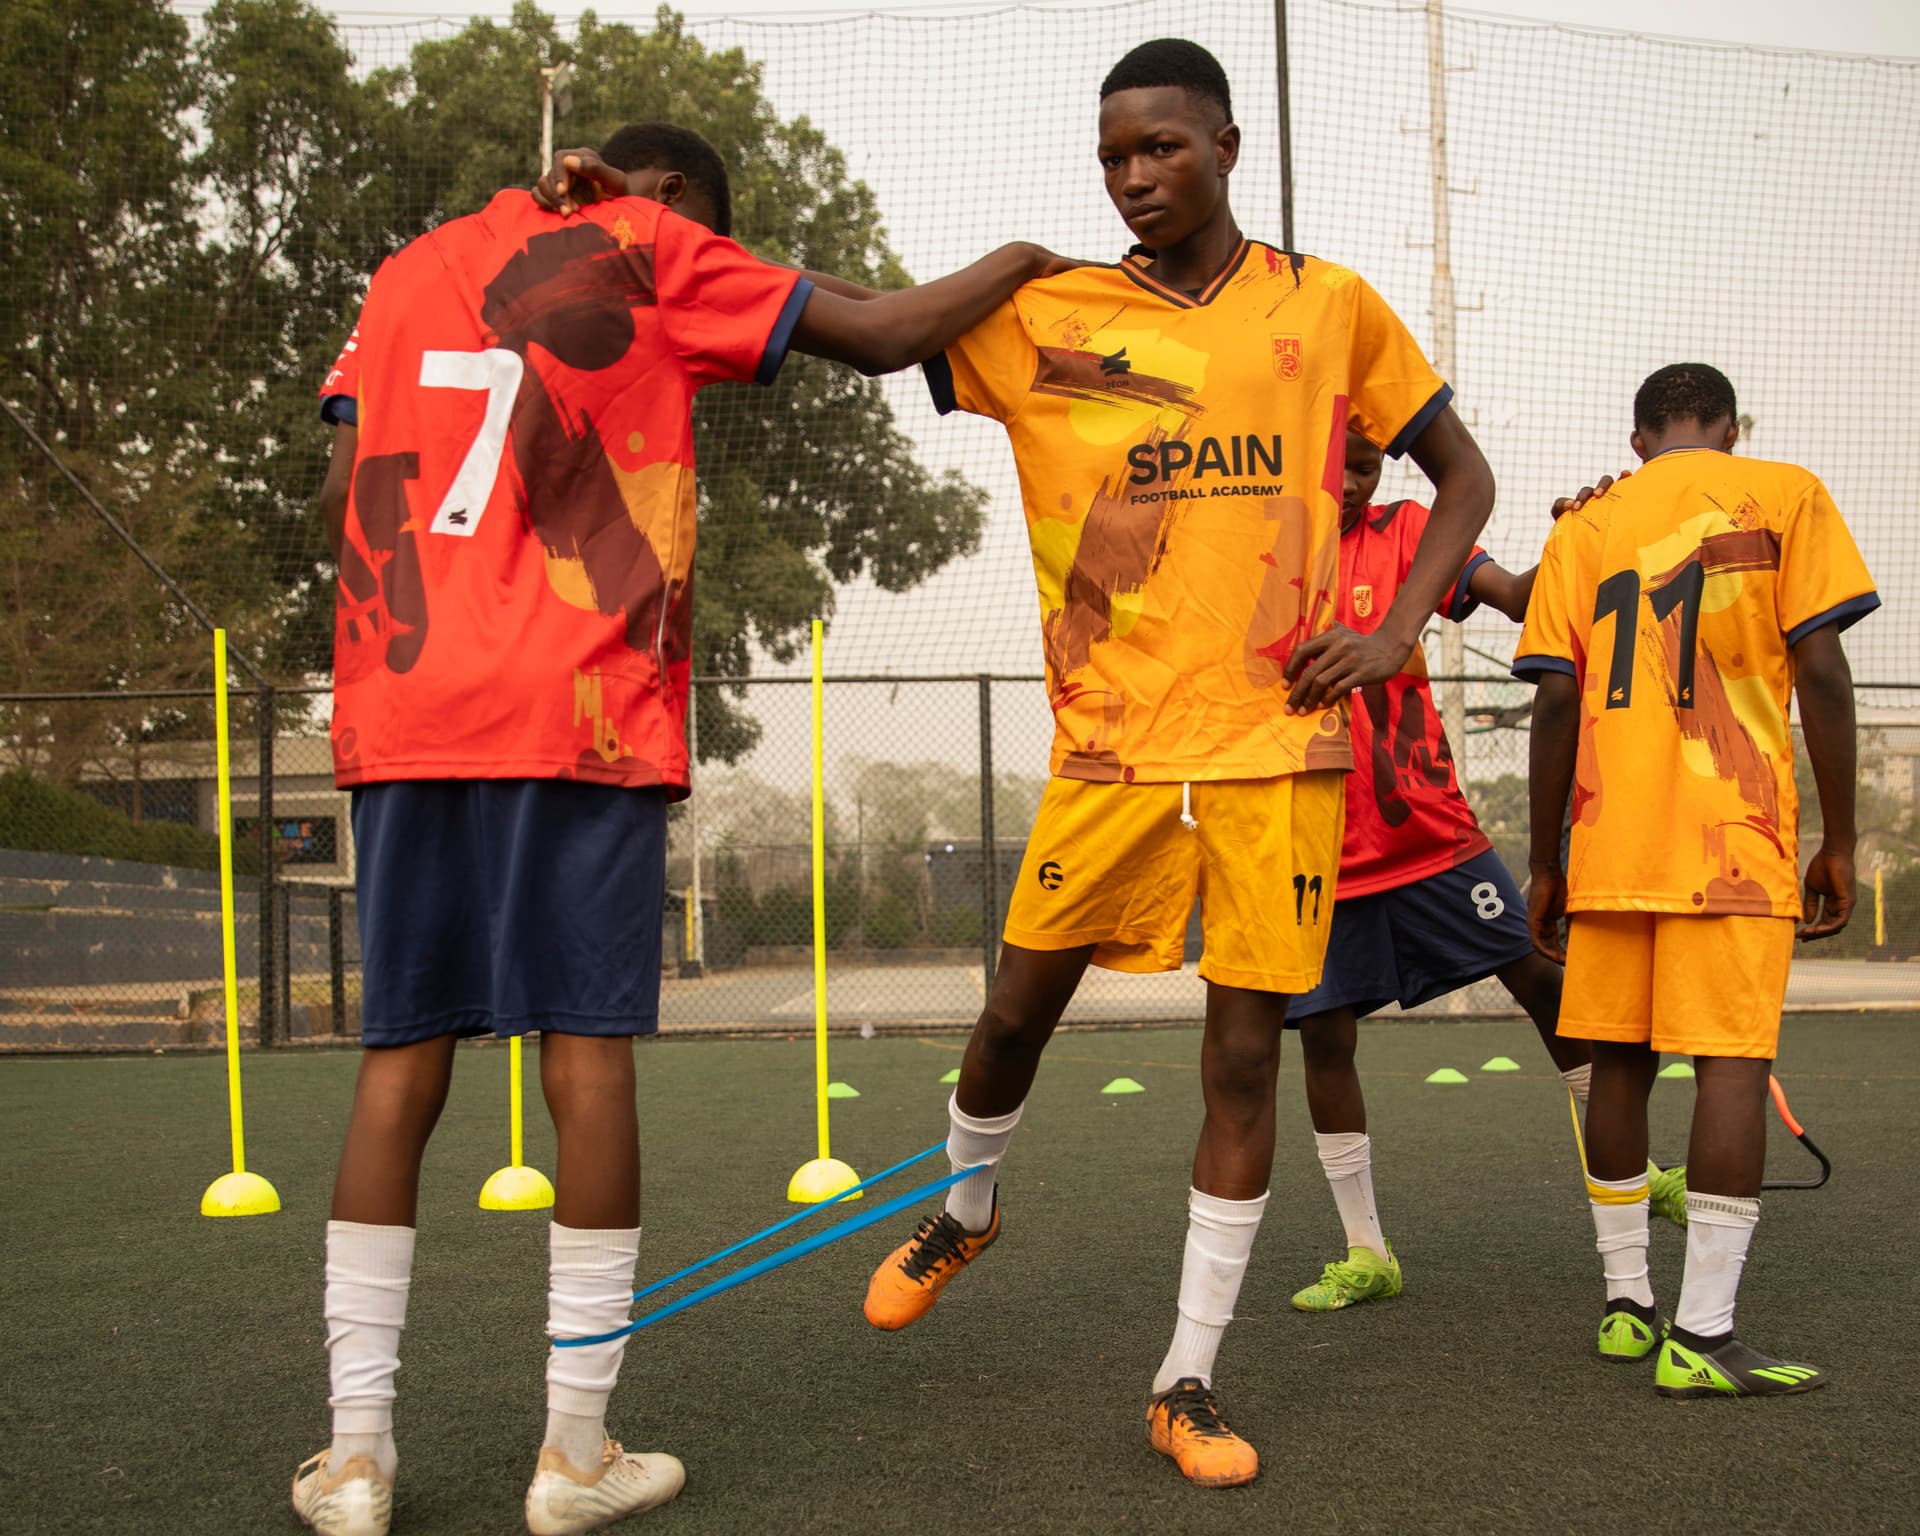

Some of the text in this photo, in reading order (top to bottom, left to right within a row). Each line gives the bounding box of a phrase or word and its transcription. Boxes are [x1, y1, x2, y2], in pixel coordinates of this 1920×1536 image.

[419, 348, 524, 537] 7
[1127, 434, 1282, 485] SPAIN
[1130, 485, 1283, 506] FOOTBALL ACADEMY
[1592, 561, 1705, 710] 11
[1292, 874, 1322, 926] 11
[1470, 881, 1505, 920] 8
